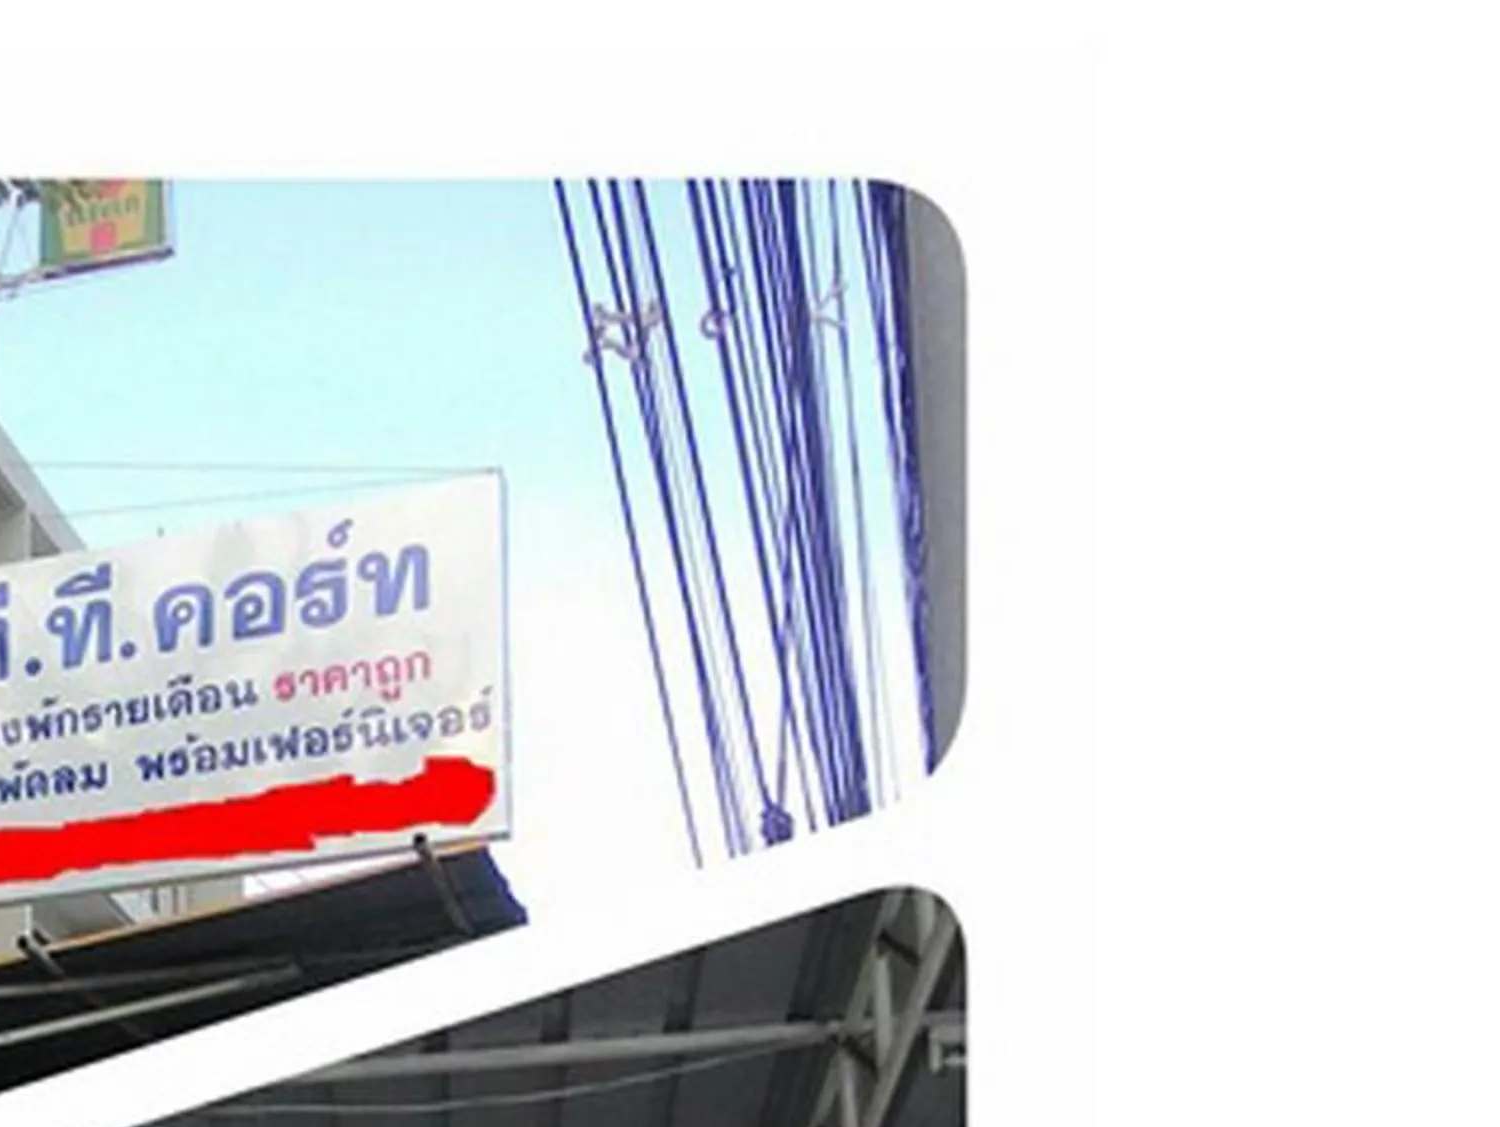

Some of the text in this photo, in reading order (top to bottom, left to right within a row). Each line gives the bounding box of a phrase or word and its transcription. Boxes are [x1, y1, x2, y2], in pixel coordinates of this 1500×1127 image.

[273, 647, 432, 705] ราคาถูก
[135, 687, 493, 783] พร้อมเฟอร์นิเจอร์
